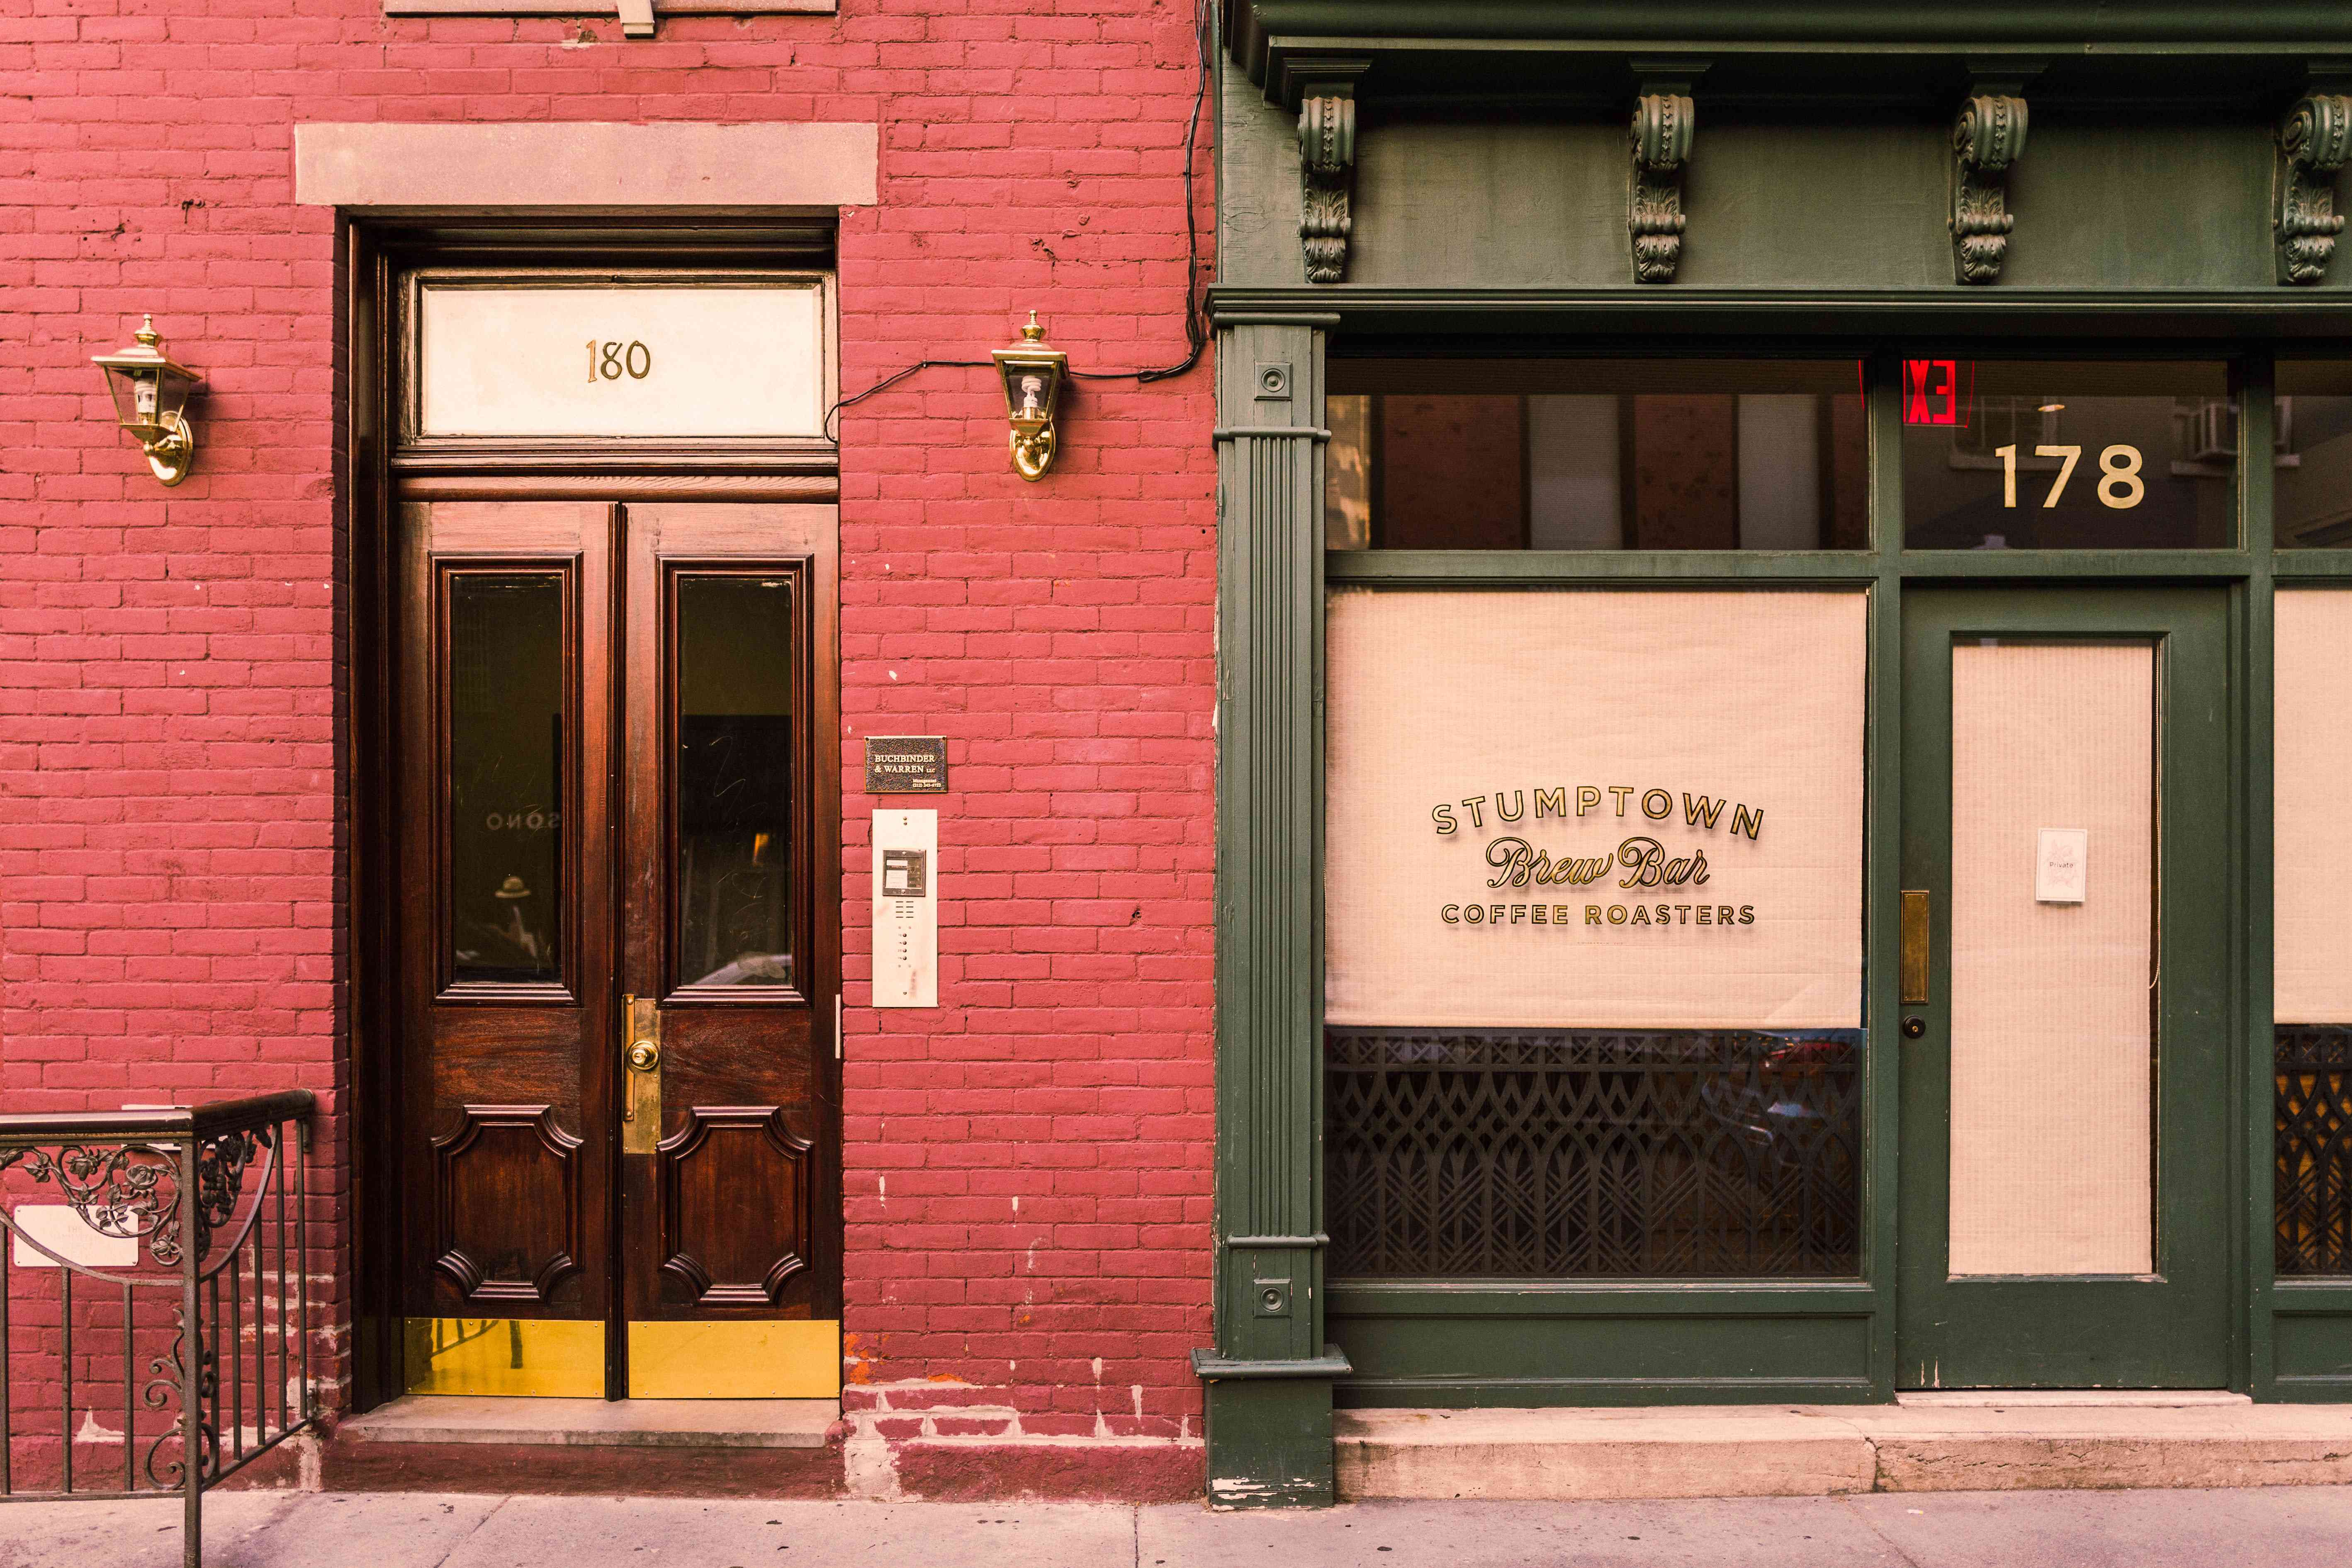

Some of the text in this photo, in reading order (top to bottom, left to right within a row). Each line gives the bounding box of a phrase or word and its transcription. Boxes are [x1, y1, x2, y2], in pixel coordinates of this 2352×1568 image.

[586, 339, 651, 383] 180
[1994, 444, 2145, 509] 178
[1432, 786, 1764, 841] STUMPTOWN
[1486, 836, 1710, 889] Brew Bar
[1441, 904, 1755, 925] COFFEE ROASTERS
